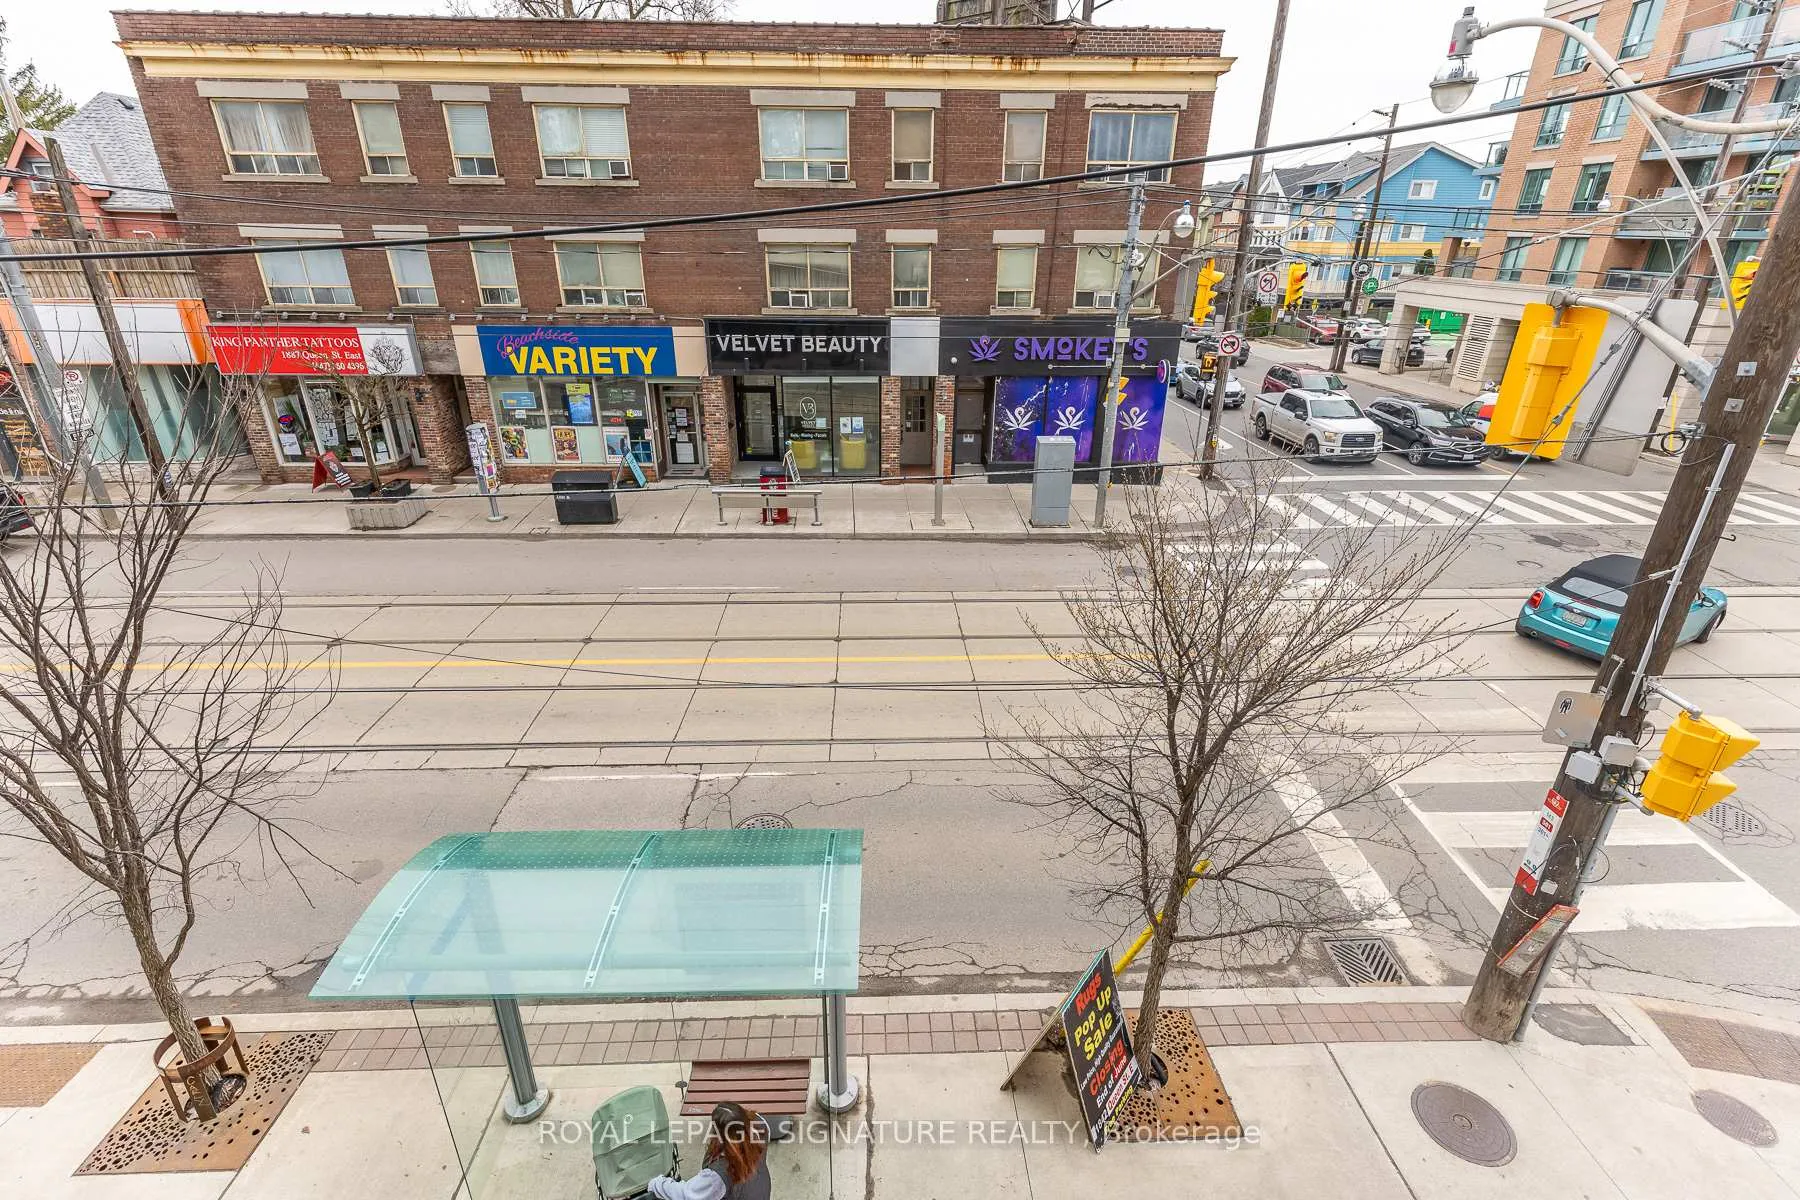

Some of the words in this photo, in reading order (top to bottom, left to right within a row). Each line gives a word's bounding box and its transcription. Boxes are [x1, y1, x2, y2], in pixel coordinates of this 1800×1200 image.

[211, 336, 241, 348] KING
[244, 336, 301, 348] PANTHER
[301, 337, 360, 349] TATTOOS
[345, 351, 362, 360] East
[506, 346, 658, 375] VARIETY
[715, 334, 796, 352] VELVET
[801, 335, 882, 353] BEAUTY
[1013, 336, 1149, 361] SMOKE'S
[1075, 972, 1102, 1016] Rugs
[1074, 1010, 1096, 1047] Pop
[1096, 986, 1111, 1012] Up
[1084, 1012, 1113, 1060] Sale
[1090, 1039, 1126, 1096] Closing
[1096, 1085, 1109, 1108] End
[1107, 1073, 1115, 1089] of
[1114, 1055, 1127, 1079] June
